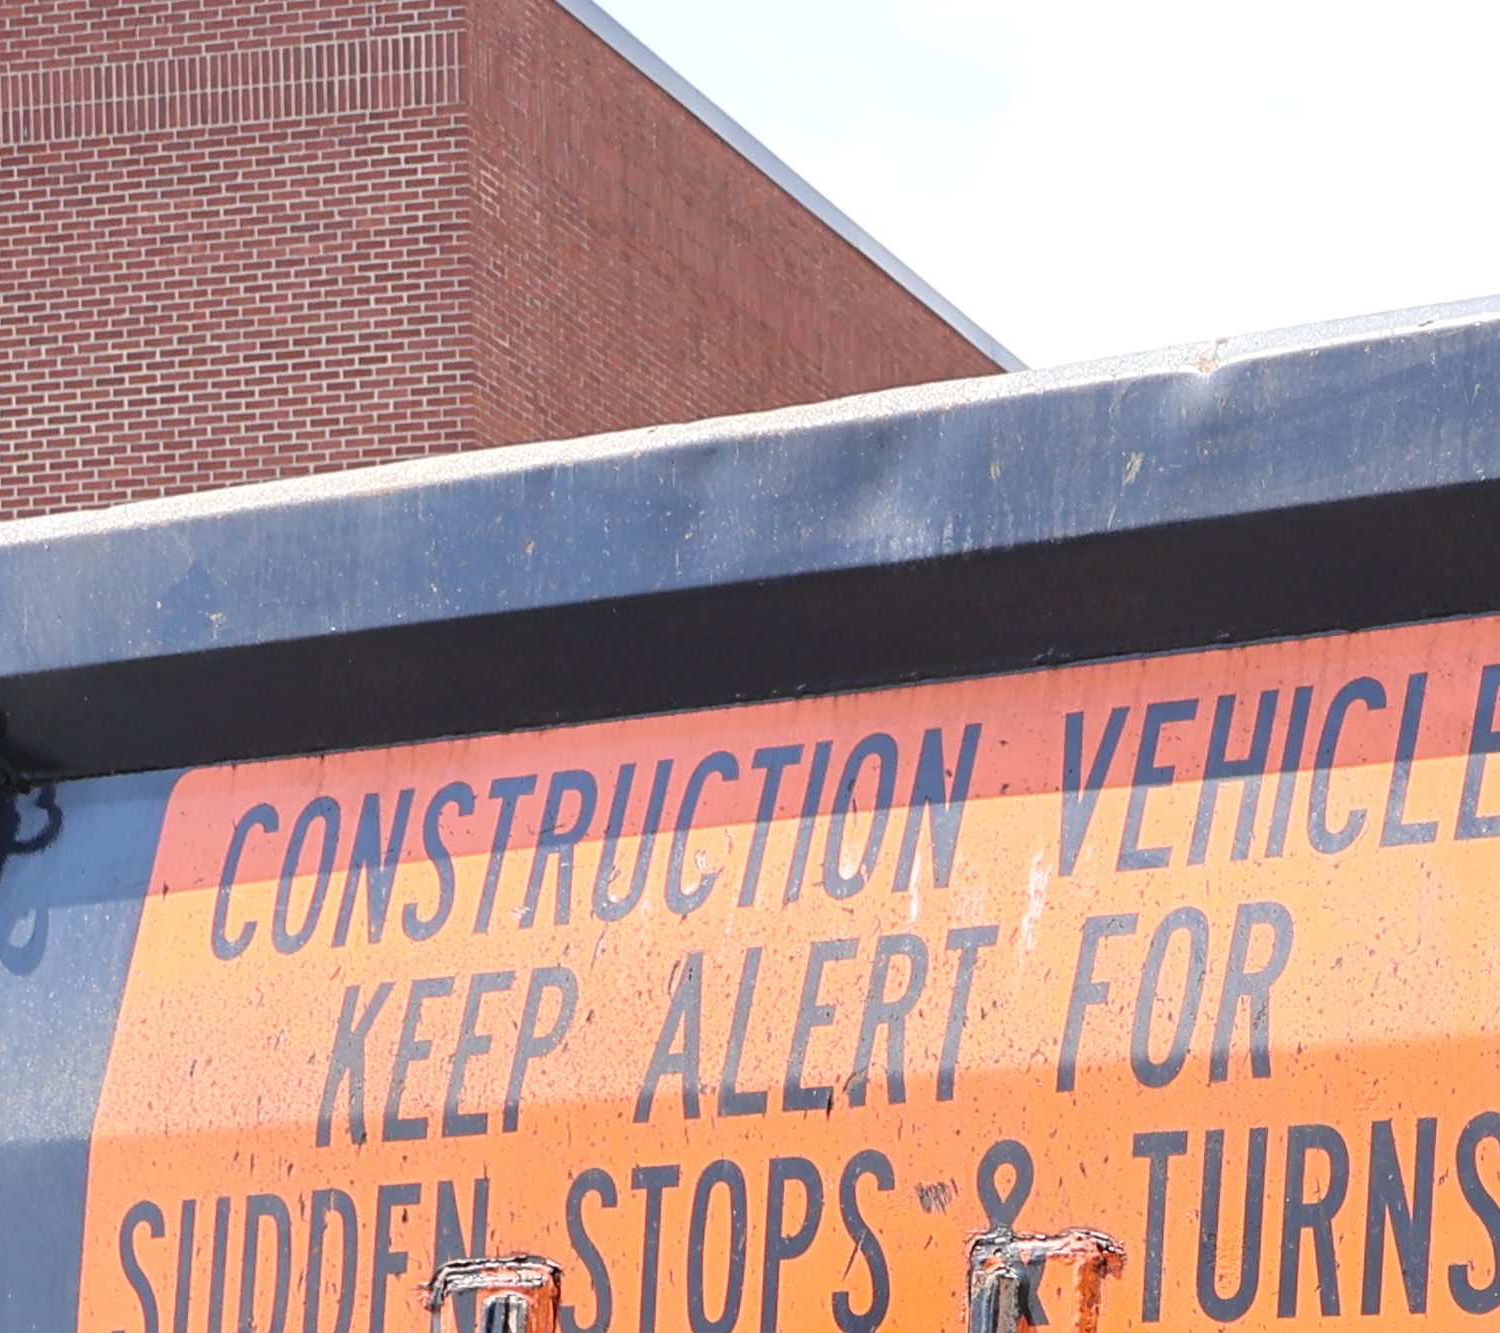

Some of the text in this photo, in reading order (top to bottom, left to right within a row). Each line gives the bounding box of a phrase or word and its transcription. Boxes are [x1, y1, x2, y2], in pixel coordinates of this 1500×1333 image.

[210, 723, 982, 960] CONSTRUCTION
[314, 900, 1295, 1147] KEEP ALERT FOR
